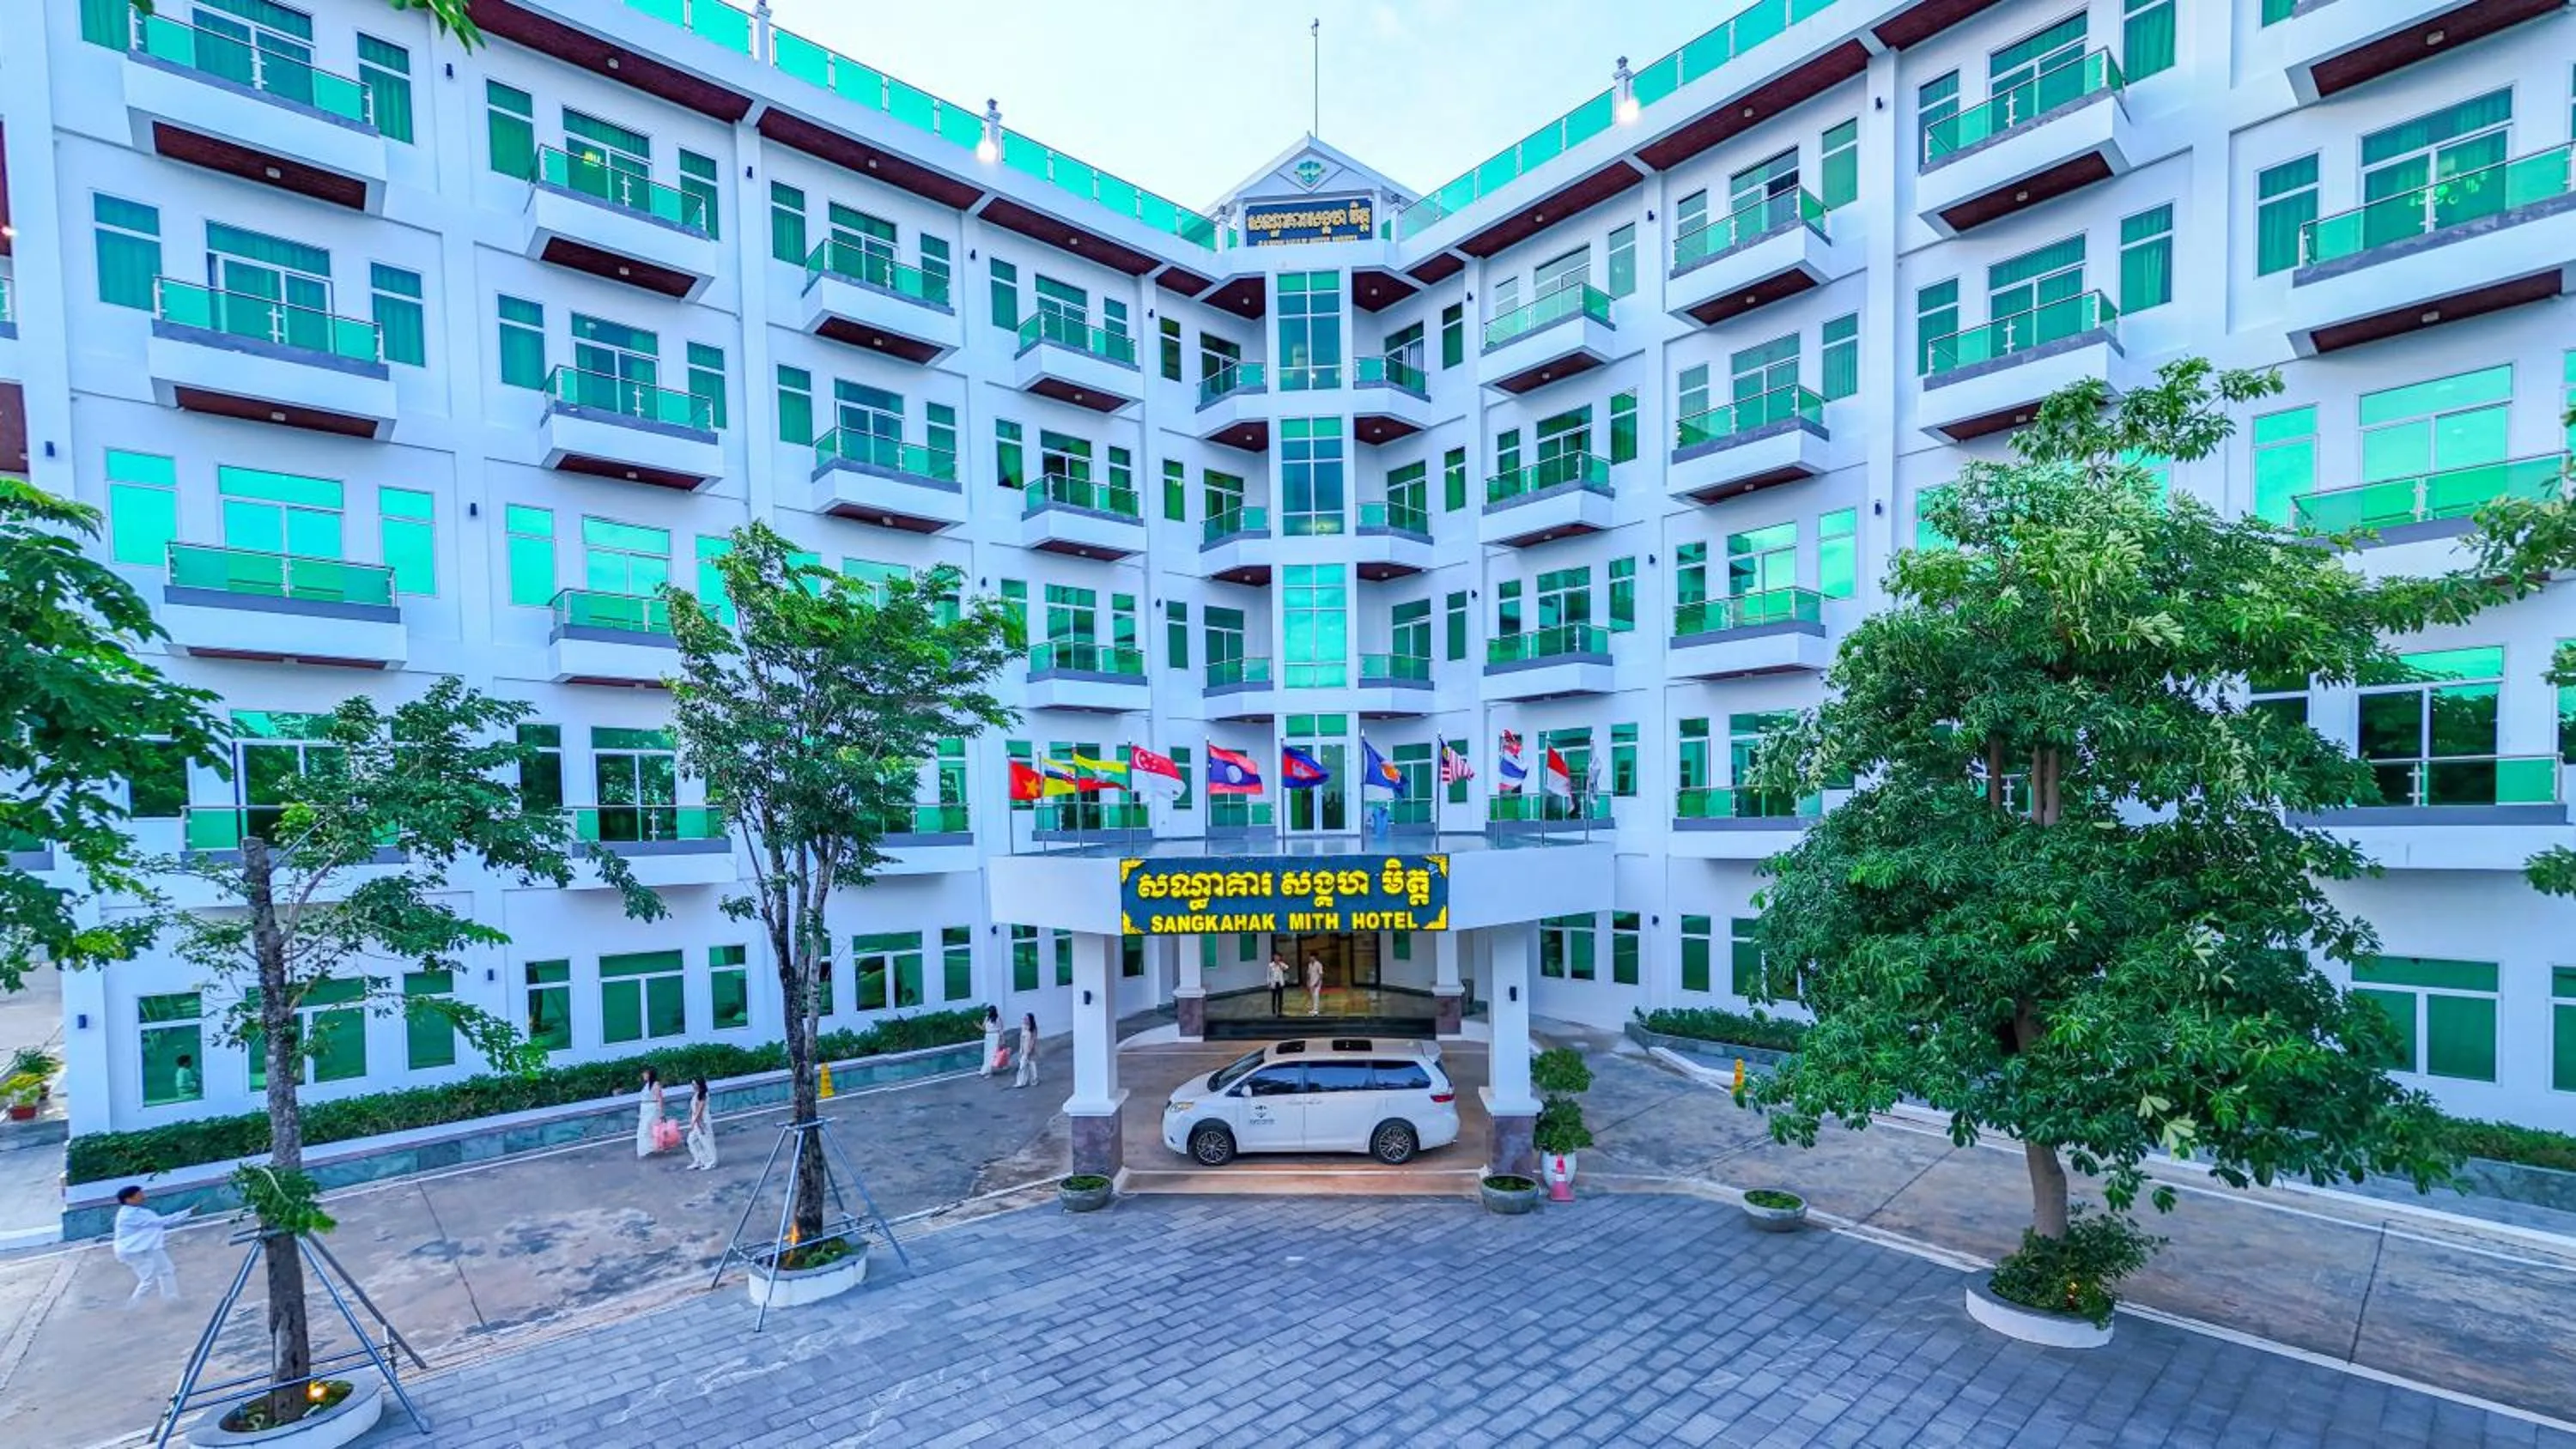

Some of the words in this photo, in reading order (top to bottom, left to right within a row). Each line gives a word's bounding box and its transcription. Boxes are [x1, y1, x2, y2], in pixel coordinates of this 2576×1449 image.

[1382, 858, 1431, 906] មិត្ត
[1151, 913, 1276, 933] SANGKAHAK
[1289, 912, 1340, 931] MITH
[1352, 911, 1419, 931] HOTEL
